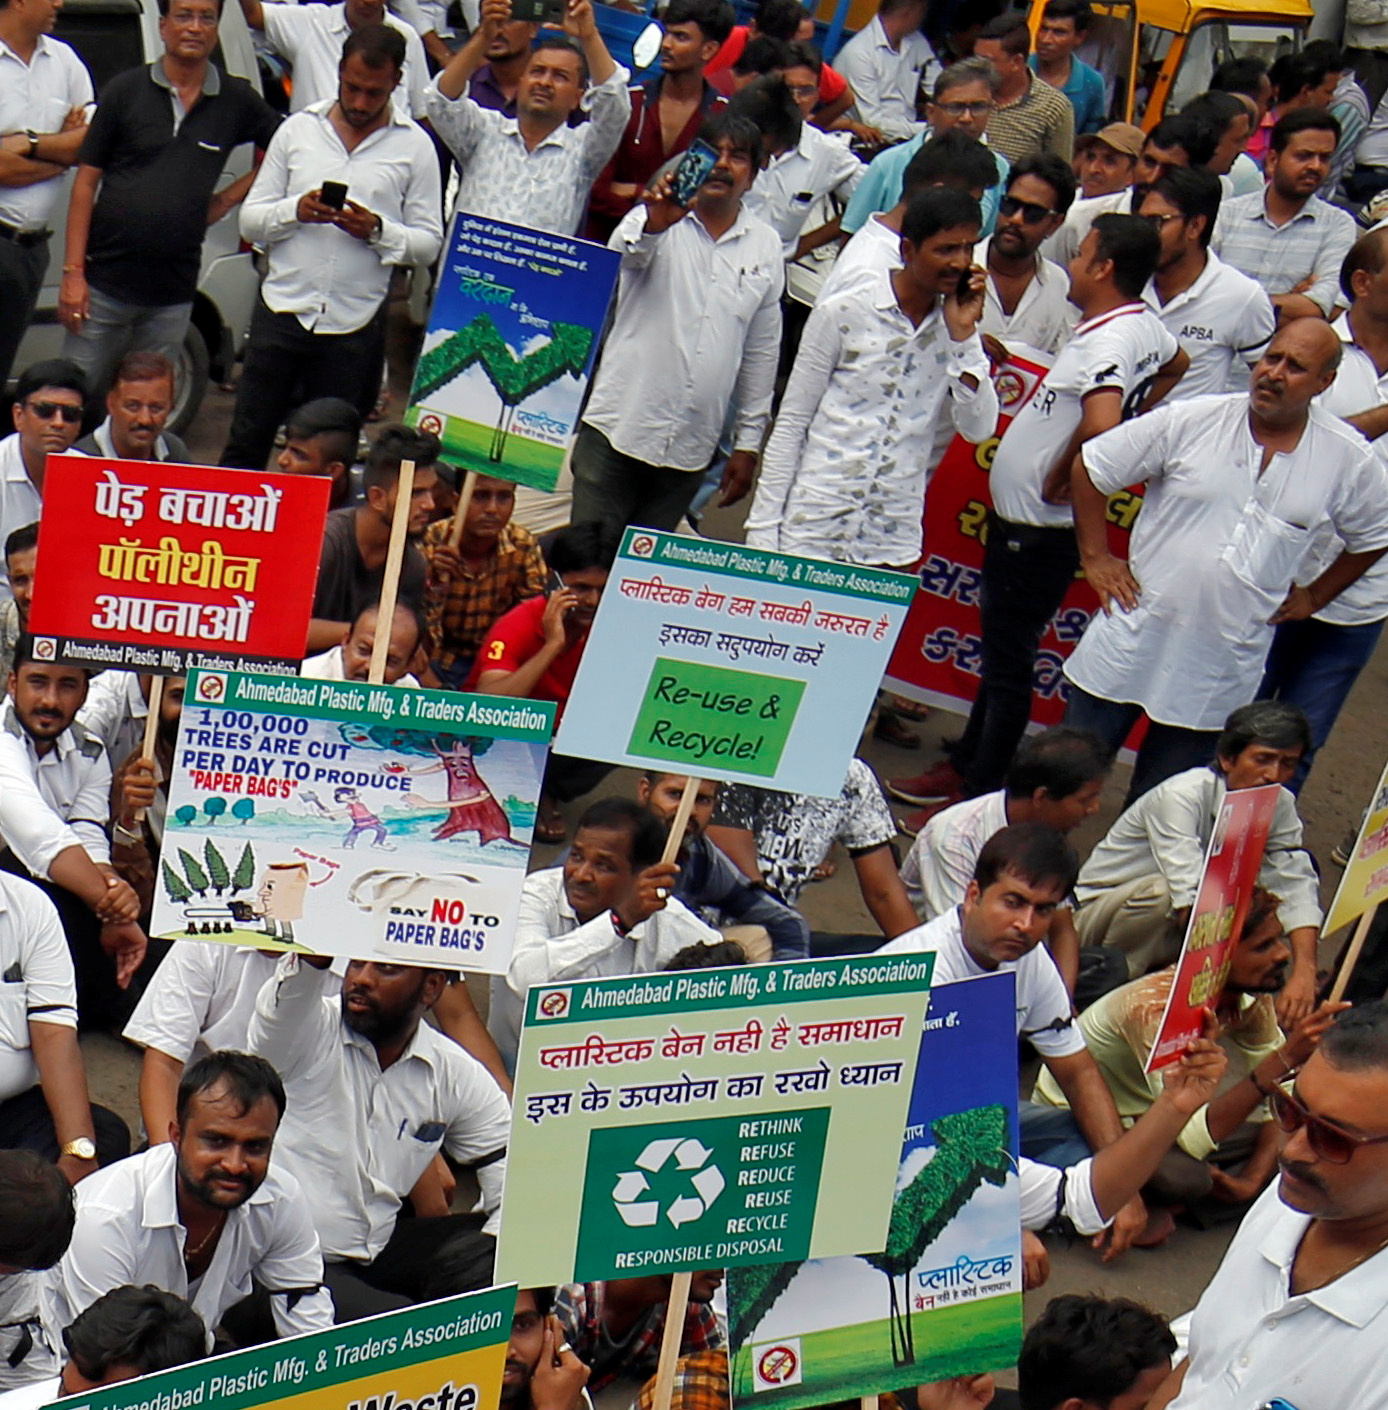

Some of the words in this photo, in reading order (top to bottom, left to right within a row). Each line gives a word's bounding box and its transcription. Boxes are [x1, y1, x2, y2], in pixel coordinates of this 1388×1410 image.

[487, 641, 504, 660] 3
[235, 677, 318, 706] Ahmedabad
[319, 685, 365, 711] Plastic
[367, 691, 395, 720] Mfg.
[399, 694, 410, 716] &
[415, 695, 465, 722] Traders
[465, 701, 546, 730] Association
[654, 677, 752, 715] Re-use
[759, 695, 780, 719] &
[200, 709, 308, 736] 1,00,000
[185, 728, 257, 751] TREES
[258, 736, 302, 756] ARE
[307, 740, 354, 761] CUT
[649, 720, 763, 760] Recycle!
[182, 750, 227, 776] PER
[232, 757, 275, 777] DAY
[283, 761, 310, 782] TO
[315, 769, 412, 792] PRODUCE
[192, 771, 242, 794] "PAPER
[247, 778, 298, 799] BAG'S"
[390, 907, 427, 918] SAY
[431, 898, 464, 925] NO
[469, 914, 499, 928] TO
[385, 921, 436, 946] PAPER
[439, 927, 485, 951] BAG'S
[739, 1117, 803, 1138] RETHINK
[740, 1142, 795, 1162] REFUSE
[738, 1166, 795, 1186] REDUCE
[745, 1189, 792, 1208] REUSE
[726, 1213, 788, 1234] RECYCLE
[615, 1244, 713, 1268] RESPONSIBLE
[716, 1237, 784, 1258] DISPOSAL
[209, 1367, 268, 1400] Plastic
[273, 1357, 308, 1384] Mfg.
[315, 1349, 327, 1372] &
[335, 1337, 397, 1367] Traders
[401, 1310, 502, 1351] Association
